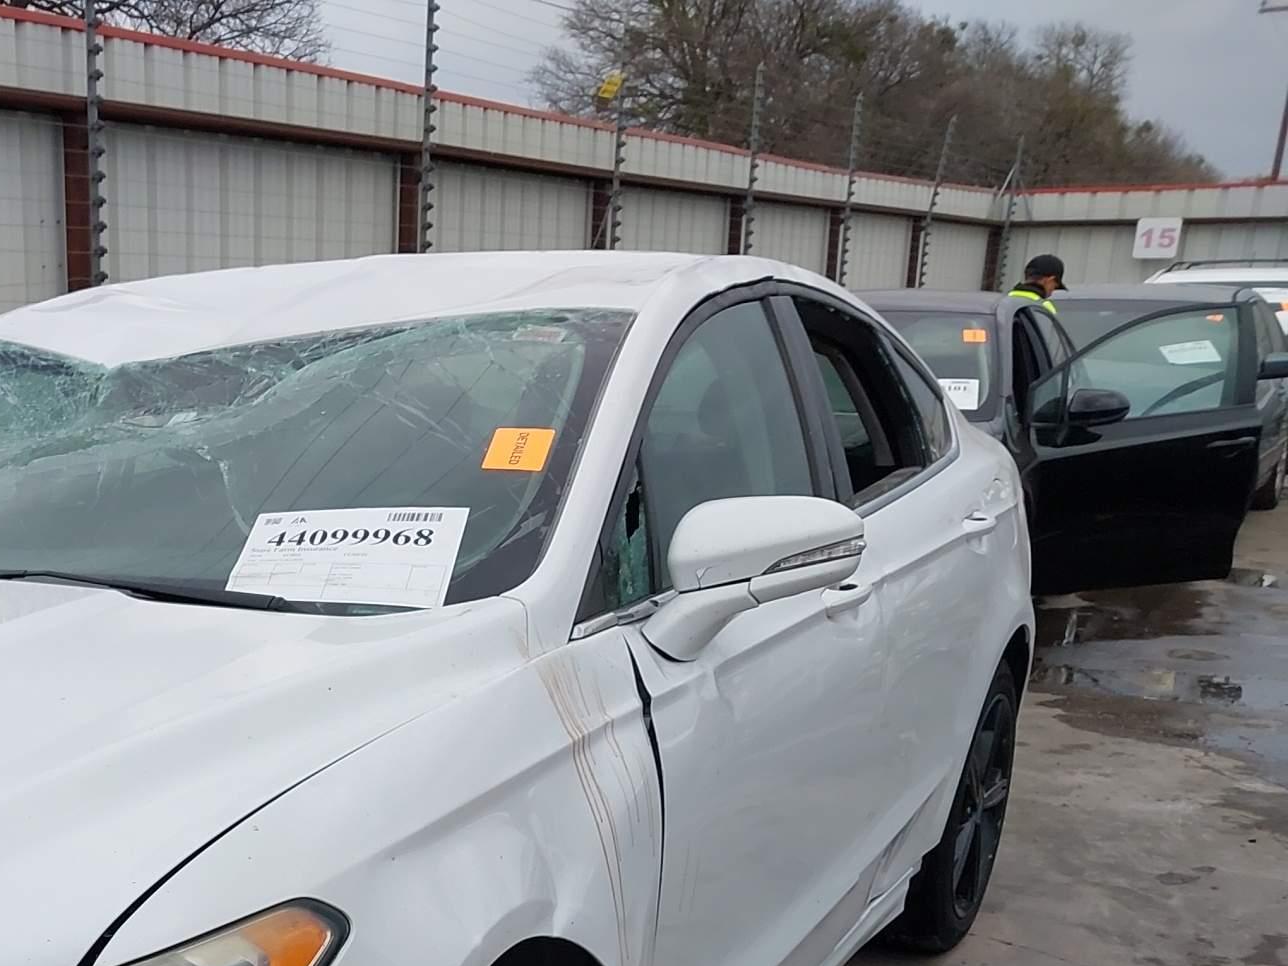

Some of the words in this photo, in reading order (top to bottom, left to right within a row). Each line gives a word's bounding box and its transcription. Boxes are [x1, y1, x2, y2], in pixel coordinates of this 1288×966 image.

[1140, 227, 1177, 249] 15
[508, 432, 530, 465] DETAILED
[267, 528, 434, 547] 44099968
